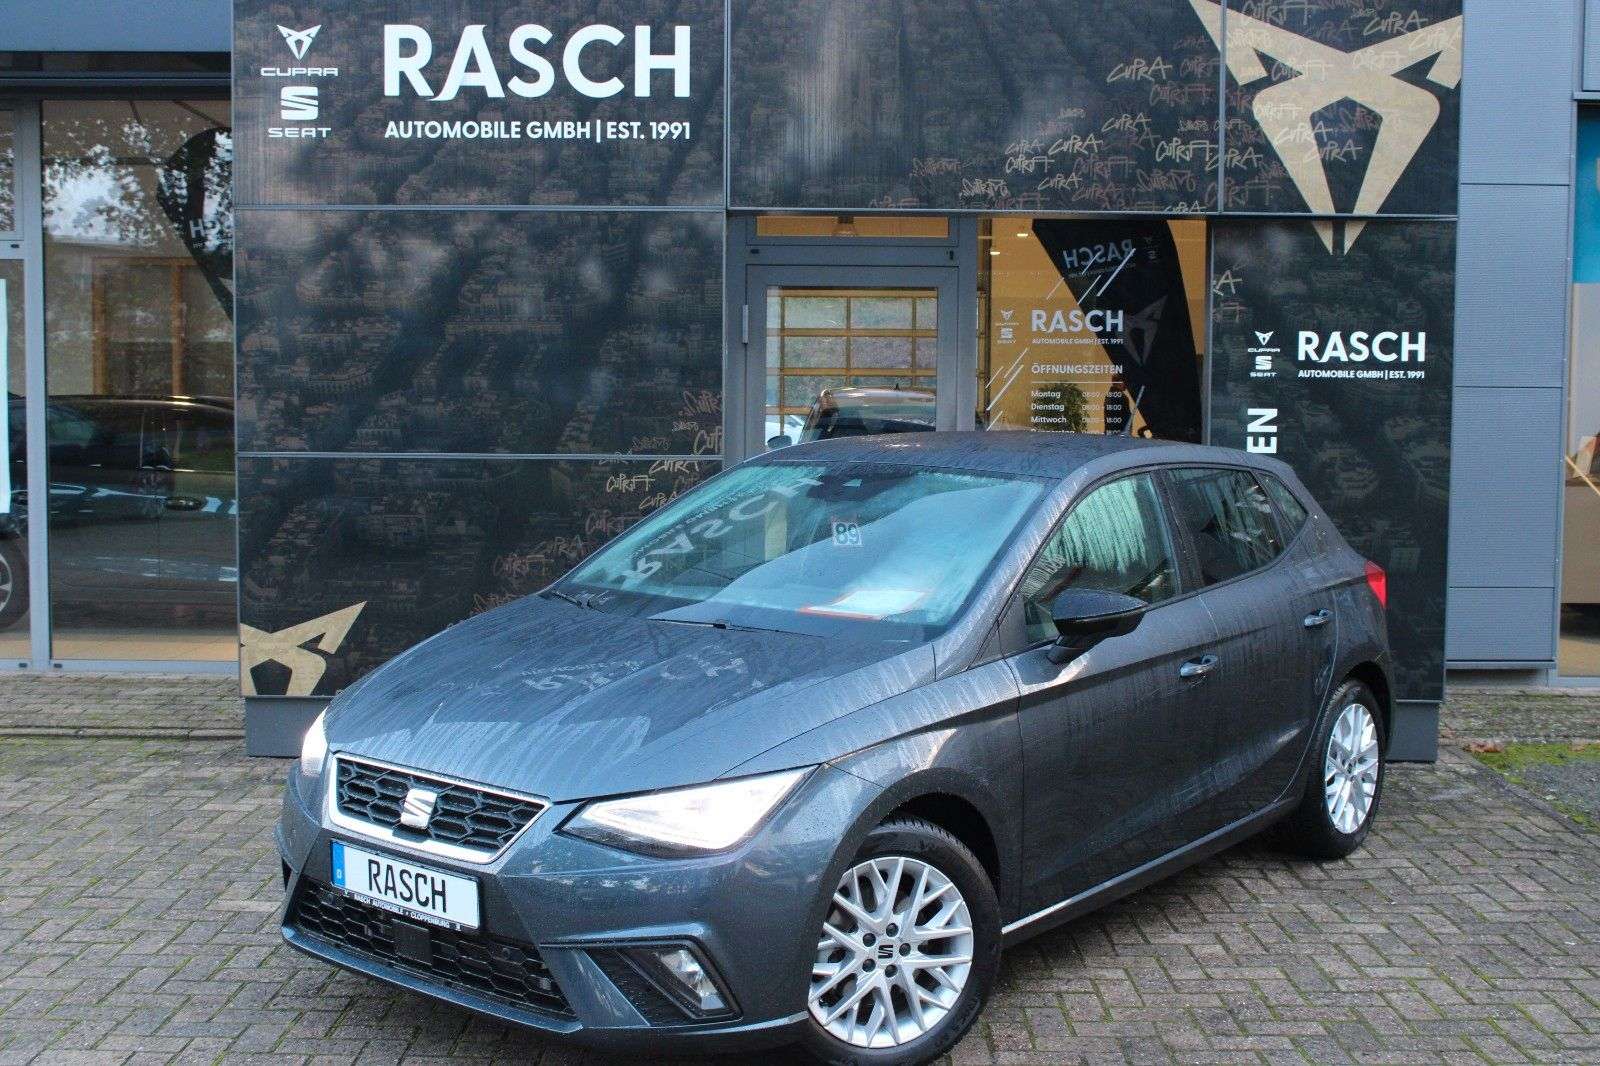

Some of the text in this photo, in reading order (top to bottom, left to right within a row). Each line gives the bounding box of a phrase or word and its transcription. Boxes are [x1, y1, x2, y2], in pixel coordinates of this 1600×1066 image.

[1363, 10, 1428, 36] CUPRA
[260, 67, 338, 77] CUPRA
[384, 24, 691, 101] RASCH
[1106, 56, 1172, 83] CUPRA
[268, 127, 331, 138] SEAT
[384, 120, 691, 140] AUTOMOBILE GMBH EST. 1991
[1101, 112, 1151, 133] CUPRA
[1047, 133, 1103, 155] CUPRA
[1155, 137, 1219, 163] CUPRA
[1038, 172, 1083, 190] CUPRA
[1031, 309, 1124, 333] RASCH
[1298, 330, 1426, 363] RASCH
[1031, 363, 1123, 374] ÖFFNUNGSZEITEN
[1298, 370, 1425, 379] AUTOMOBILE GMBH EST. 1991
[1031, 391, 1061, 399] Montag
[1031, 403, 1065, 412] Dienstag
[1031, 416, 1067, 424] Mittwoch
[606, 473, 656, 493] CUPRA
[367, 858, 447, 913] RASCH
